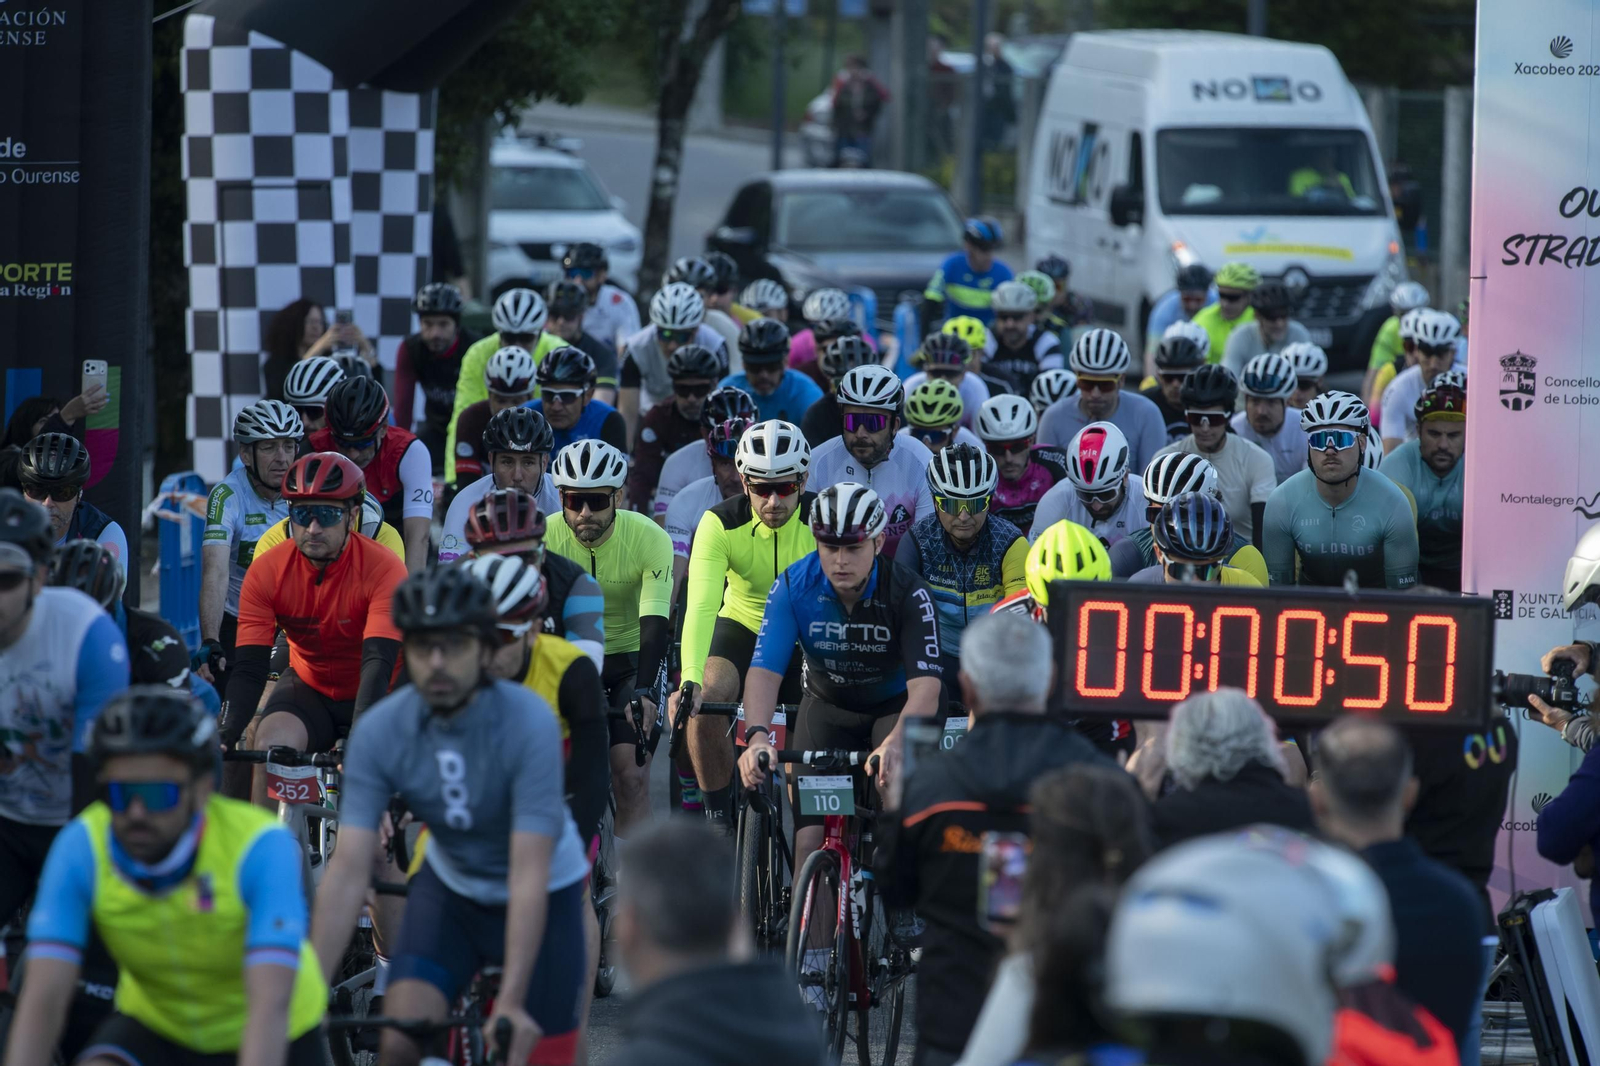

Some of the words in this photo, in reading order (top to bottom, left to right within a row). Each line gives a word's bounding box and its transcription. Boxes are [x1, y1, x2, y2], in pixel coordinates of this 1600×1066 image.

[1514, 62, 1576, 77] Xacobeo
[12, 168, 80, 184] Ourense
[0, 263, 73, 282] ORTE
[1544, 376, 1600, 389] Concello
[1544, 393, 1560, 404] de
[1500, 493, 1575, 508] Montalegre
[1519, 607, 1535, 619] DE
[275, 782, 311, 800] 252
[813, 795, 841, 811] 110
[1499, 820, 1538, 833] acob
